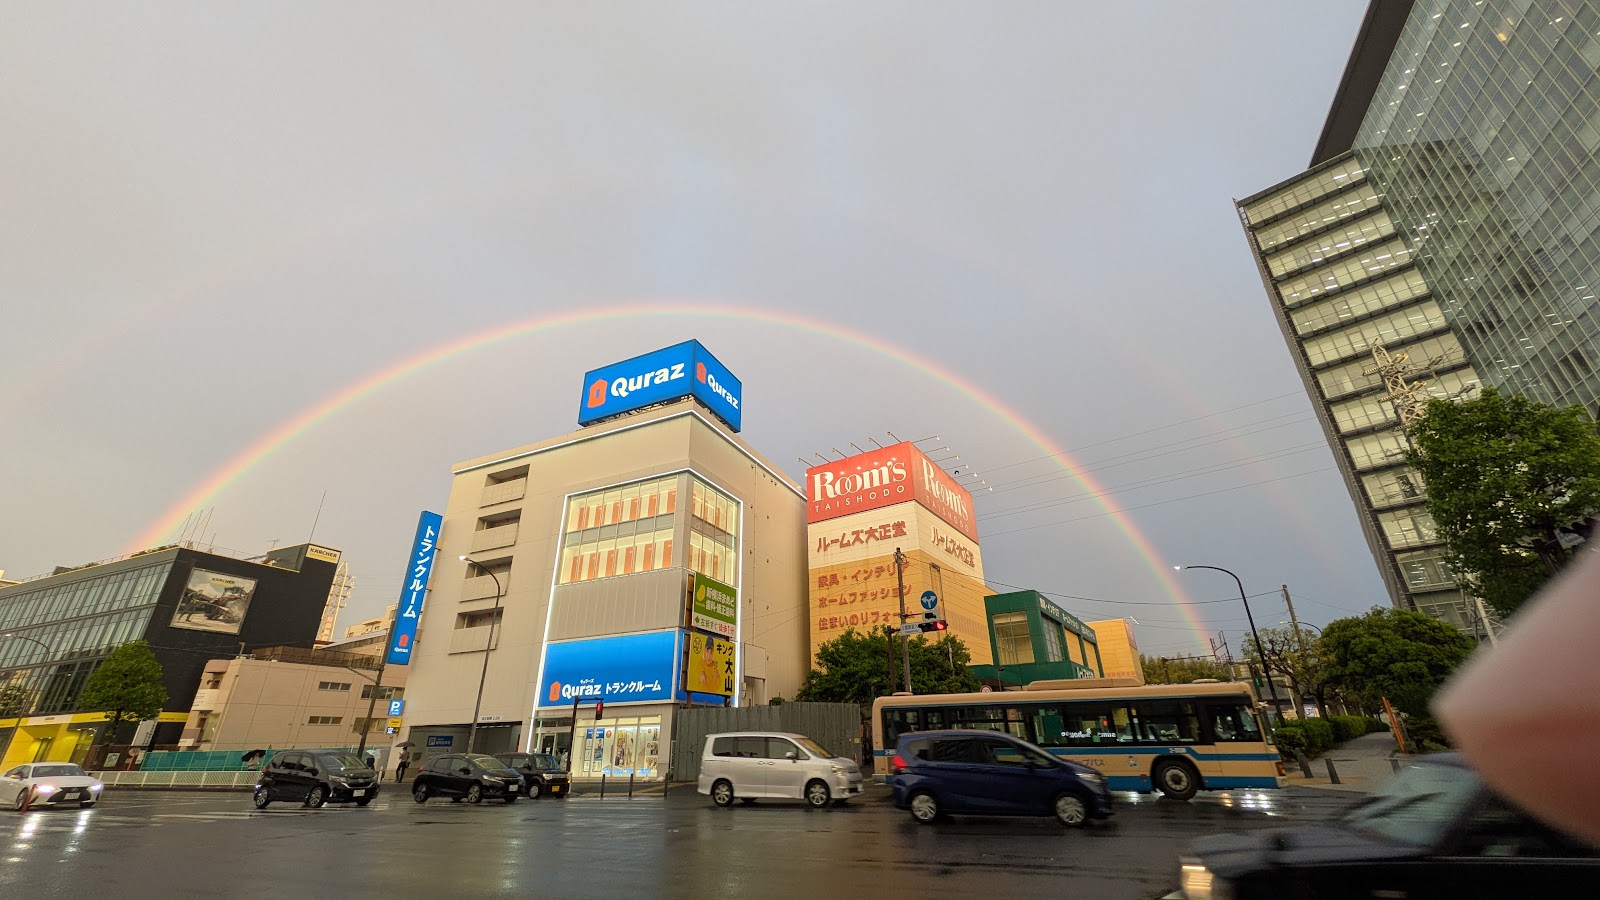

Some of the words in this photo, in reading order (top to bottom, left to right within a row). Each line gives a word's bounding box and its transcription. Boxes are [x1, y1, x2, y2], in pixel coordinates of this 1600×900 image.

[611, 363, 685, 398] Quraz
[707, 374, 739, 409] Quraz
[812, 460, 907, 503] Room's
[815, 485, 905, 513] TAISHODO
[921, 456, 969, 521] Room's
[925, 495, 969, 533] TAISHODO
[817, 520, 908, 552] ルームズ大正堂
[931, 526, 975, 568] ルームズ大正堂
[403, 525, 435, 619] トランクルーム
[819, 584, 912, 608] ホームファッション
[716, 643, 734, 657] キング
[562, 684, 602, 699] Quraz
[605, 680, 661, 694] トランクルーム
[724, 658, 734, 693] 大山
